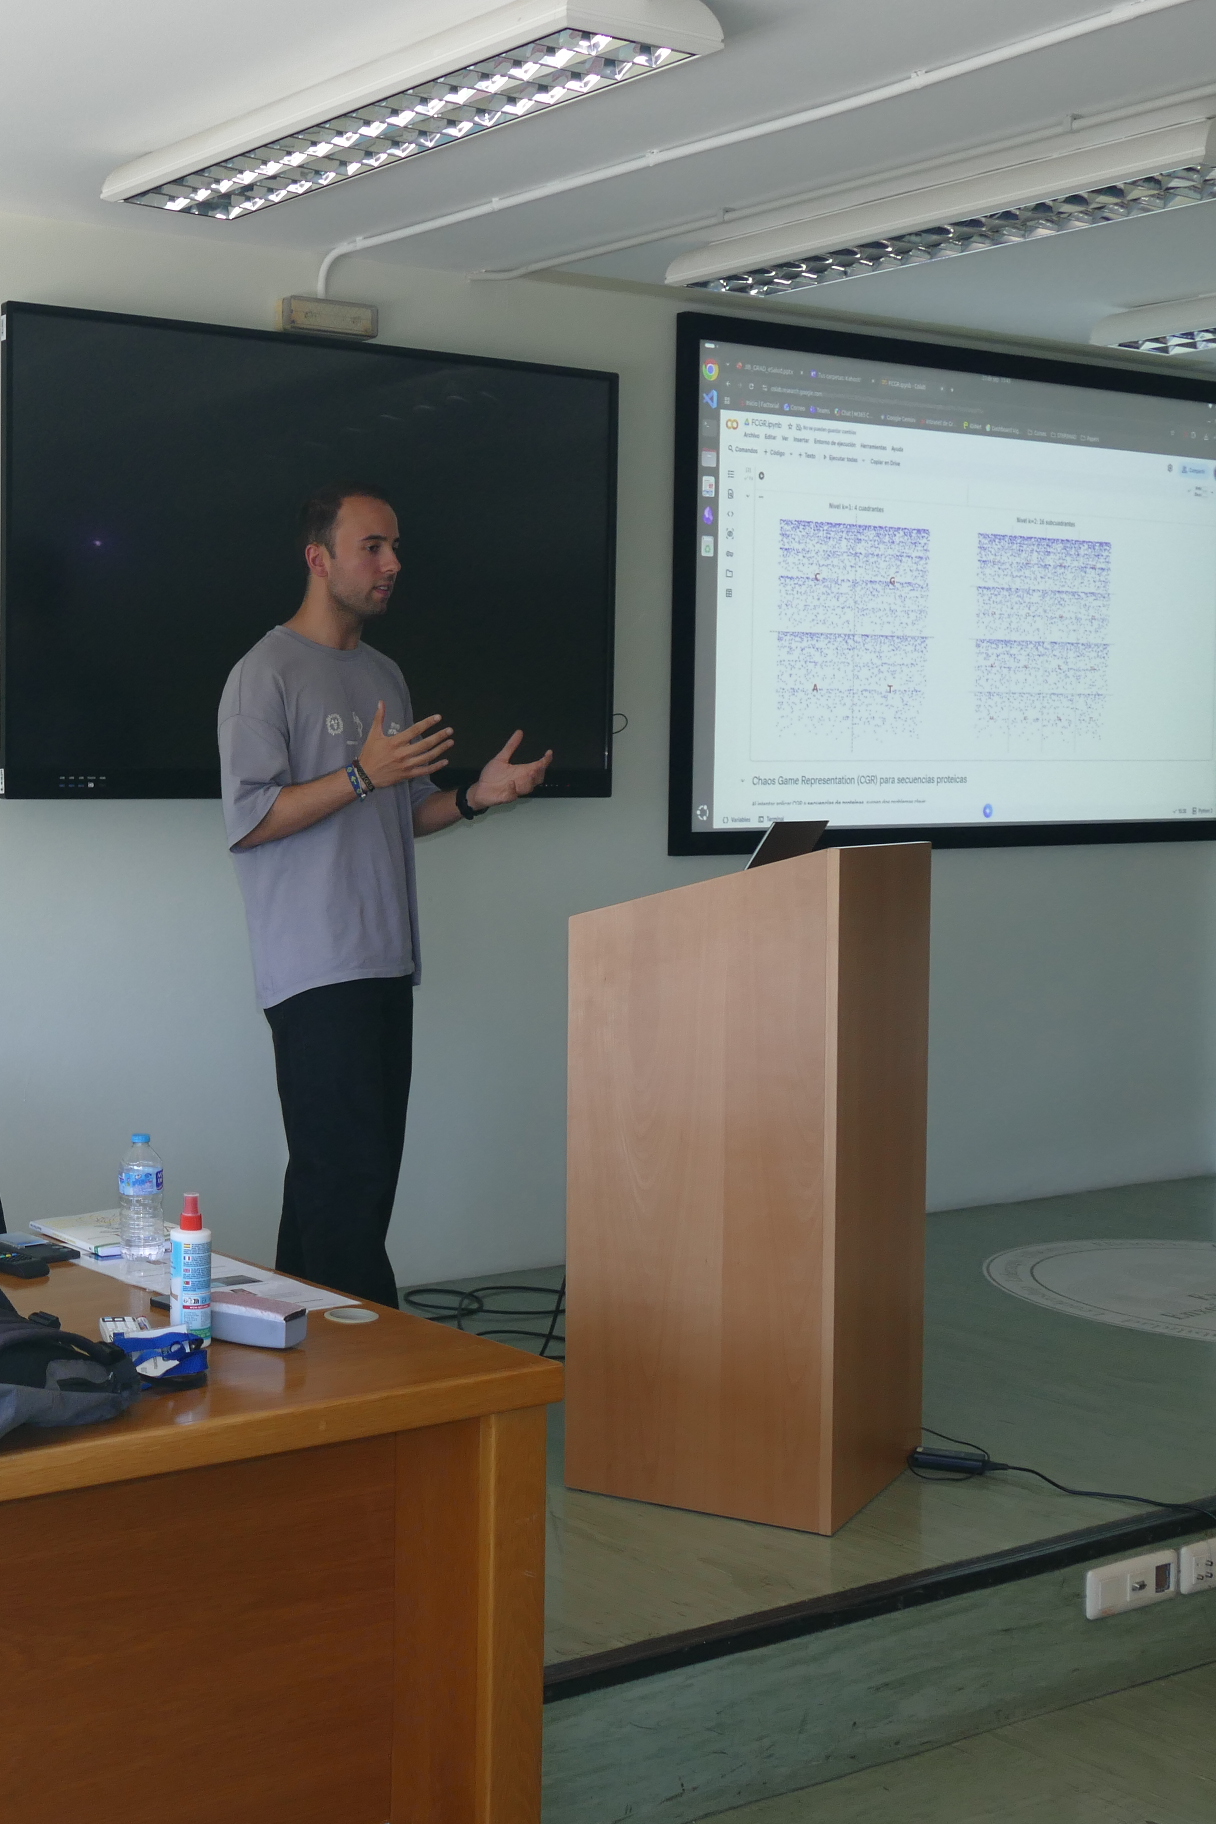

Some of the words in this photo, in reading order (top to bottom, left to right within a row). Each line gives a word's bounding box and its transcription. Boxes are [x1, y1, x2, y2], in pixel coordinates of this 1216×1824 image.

[751, 418, 782, 429] FCGR.ipynb
[814, 438, 830, 446] Entorno
[735, 446, 758, 454] Comandos
[860, 443, 887, 451] Herramientas
[752, 775, 776, 786] Chaos
[777, 775, 799, 786] Game
[801, 775, 855, 788] Representation
[857, 775, 878, 787] (CGR)
[879, 776, 895, 787] para
[897, 775, 935, 785] secuencias
[731, 816, 751, 824] Variables
